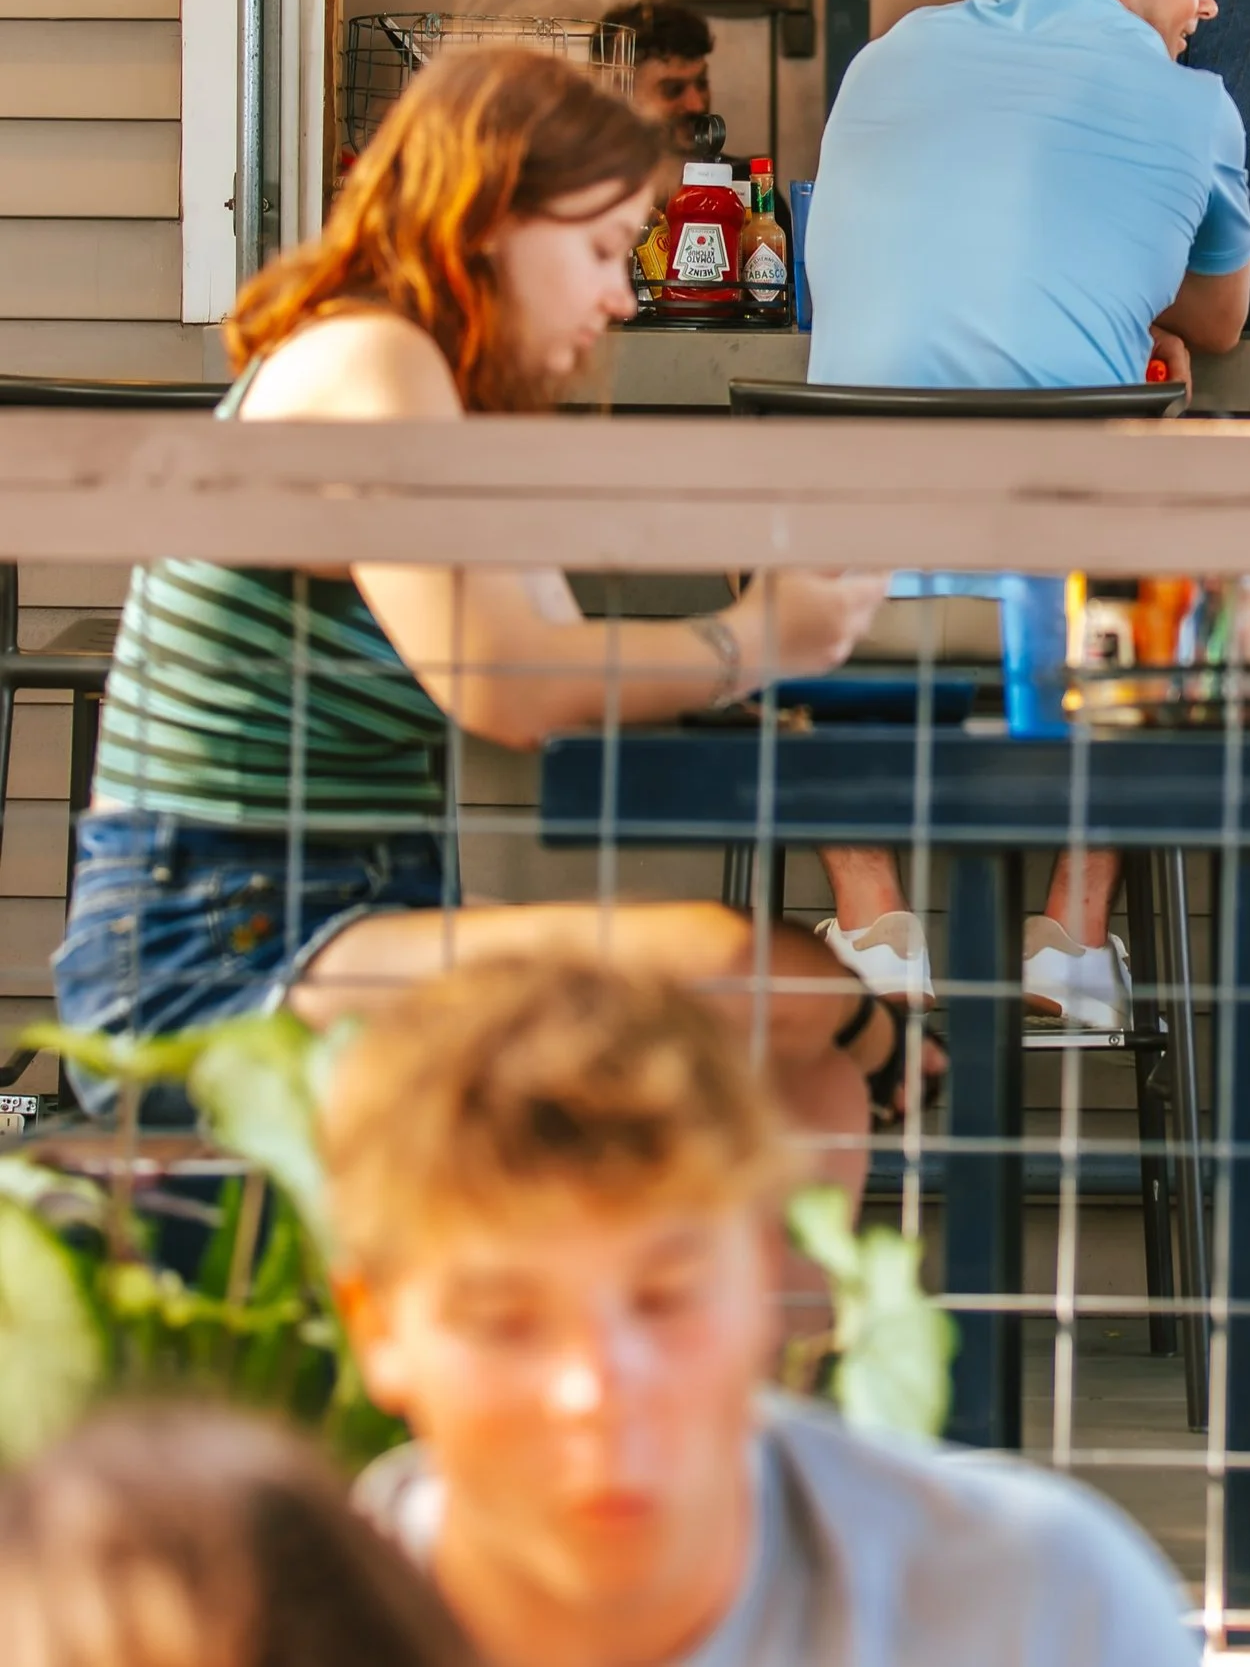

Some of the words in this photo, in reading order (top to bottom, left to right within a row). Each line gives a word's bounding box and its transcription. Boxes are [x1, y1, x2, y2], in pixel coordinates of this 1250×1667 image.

[686, 255, 715, 264] TOMATO
[688, 267, 714, 277] HEINZ
[744, 268, 785, 280] TABASCO
